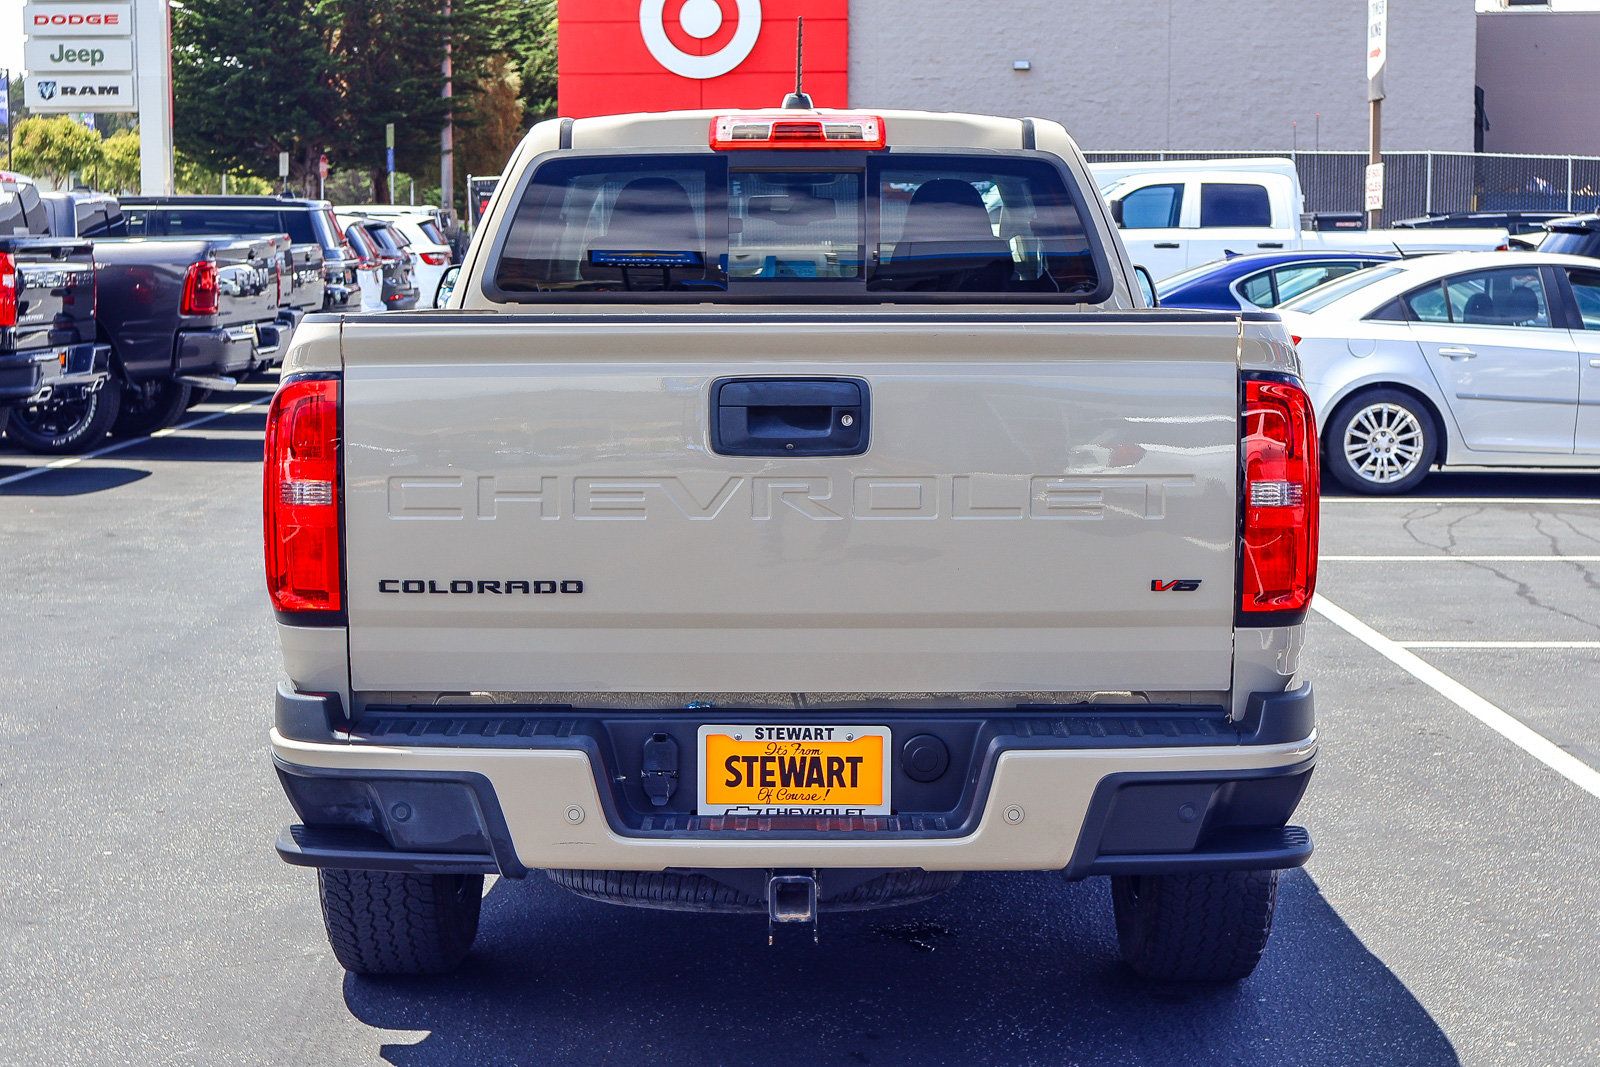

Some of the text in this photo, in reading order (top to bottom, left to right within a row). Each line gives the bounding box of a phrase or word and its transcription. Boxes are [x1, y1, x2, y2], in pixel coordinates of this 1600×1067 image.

[33, 14, 120, 26] DODGE
[50, 44, 105, 67] Jeep
[60, 85, 120, 96] RAM
[236, 268, 269, 287] RAM
[387, 475, 1196, 521] CHEVROLET
[378, 579, 584, 595] COLORADO
[1150, 579, 1203, 592] V6
[754, 726, 835, 741] STEWART
[790, 742, 823, 756] From
[724, 755, 864, 788] STEWART
[757, 787, 774, 804] Of
[766, 807, 866, 816] CHEVROLET
